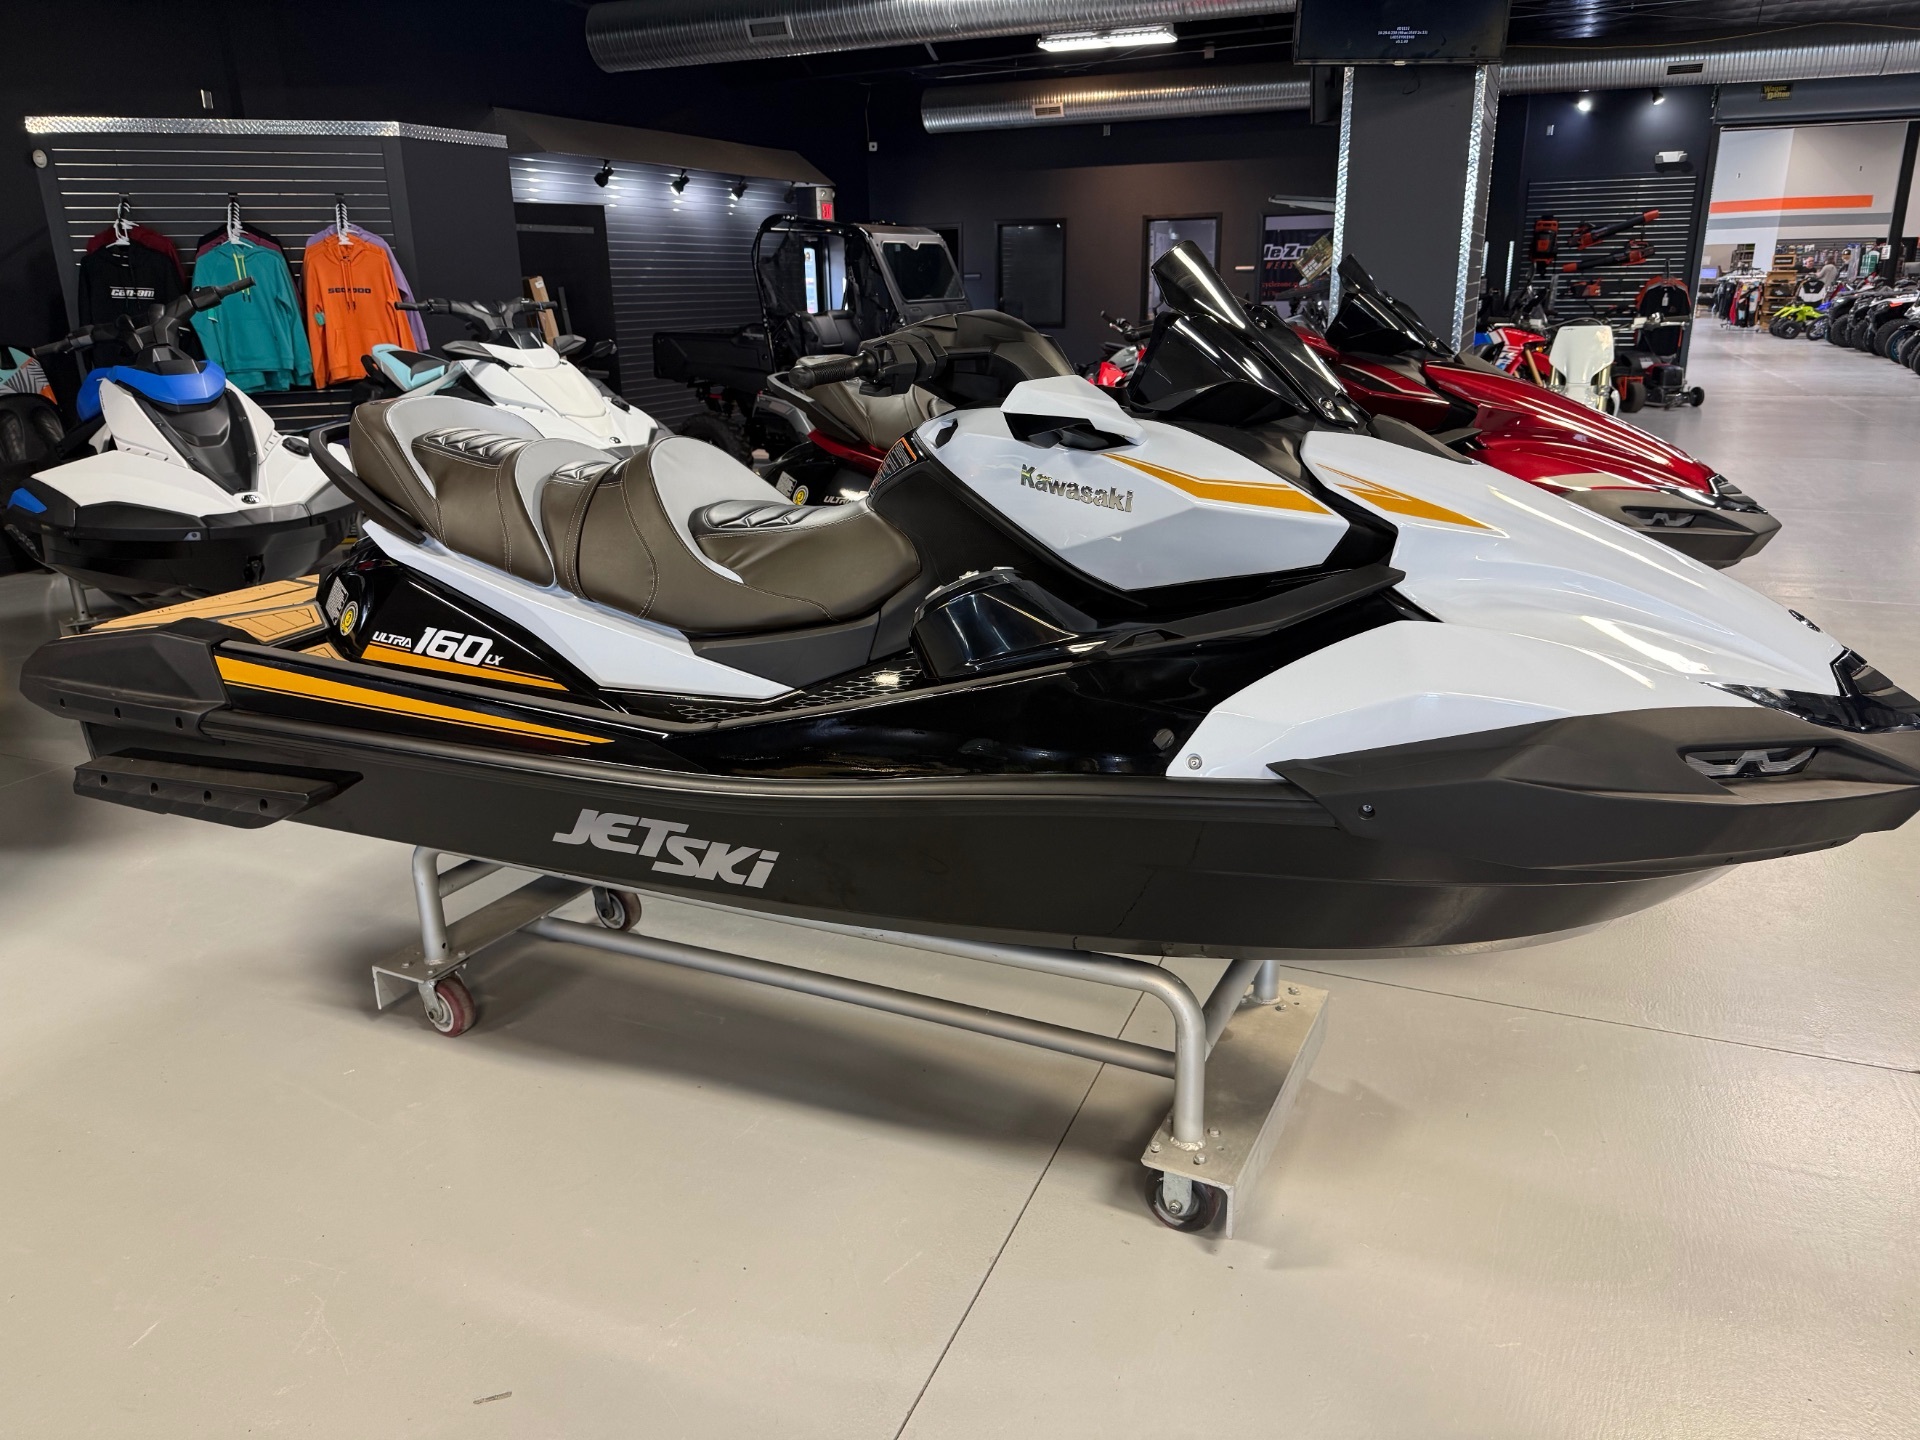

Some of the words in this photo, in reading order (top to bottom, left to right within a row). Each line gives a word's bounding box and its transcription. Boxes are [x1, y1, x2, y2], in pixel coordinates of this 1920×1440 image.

[1020, 463, 1134, 513] Kawasaki
[372, 630, 412, 648] ULTRA
[413, 626, 493, 666] 160
[484, 653, 504, 666] LX
